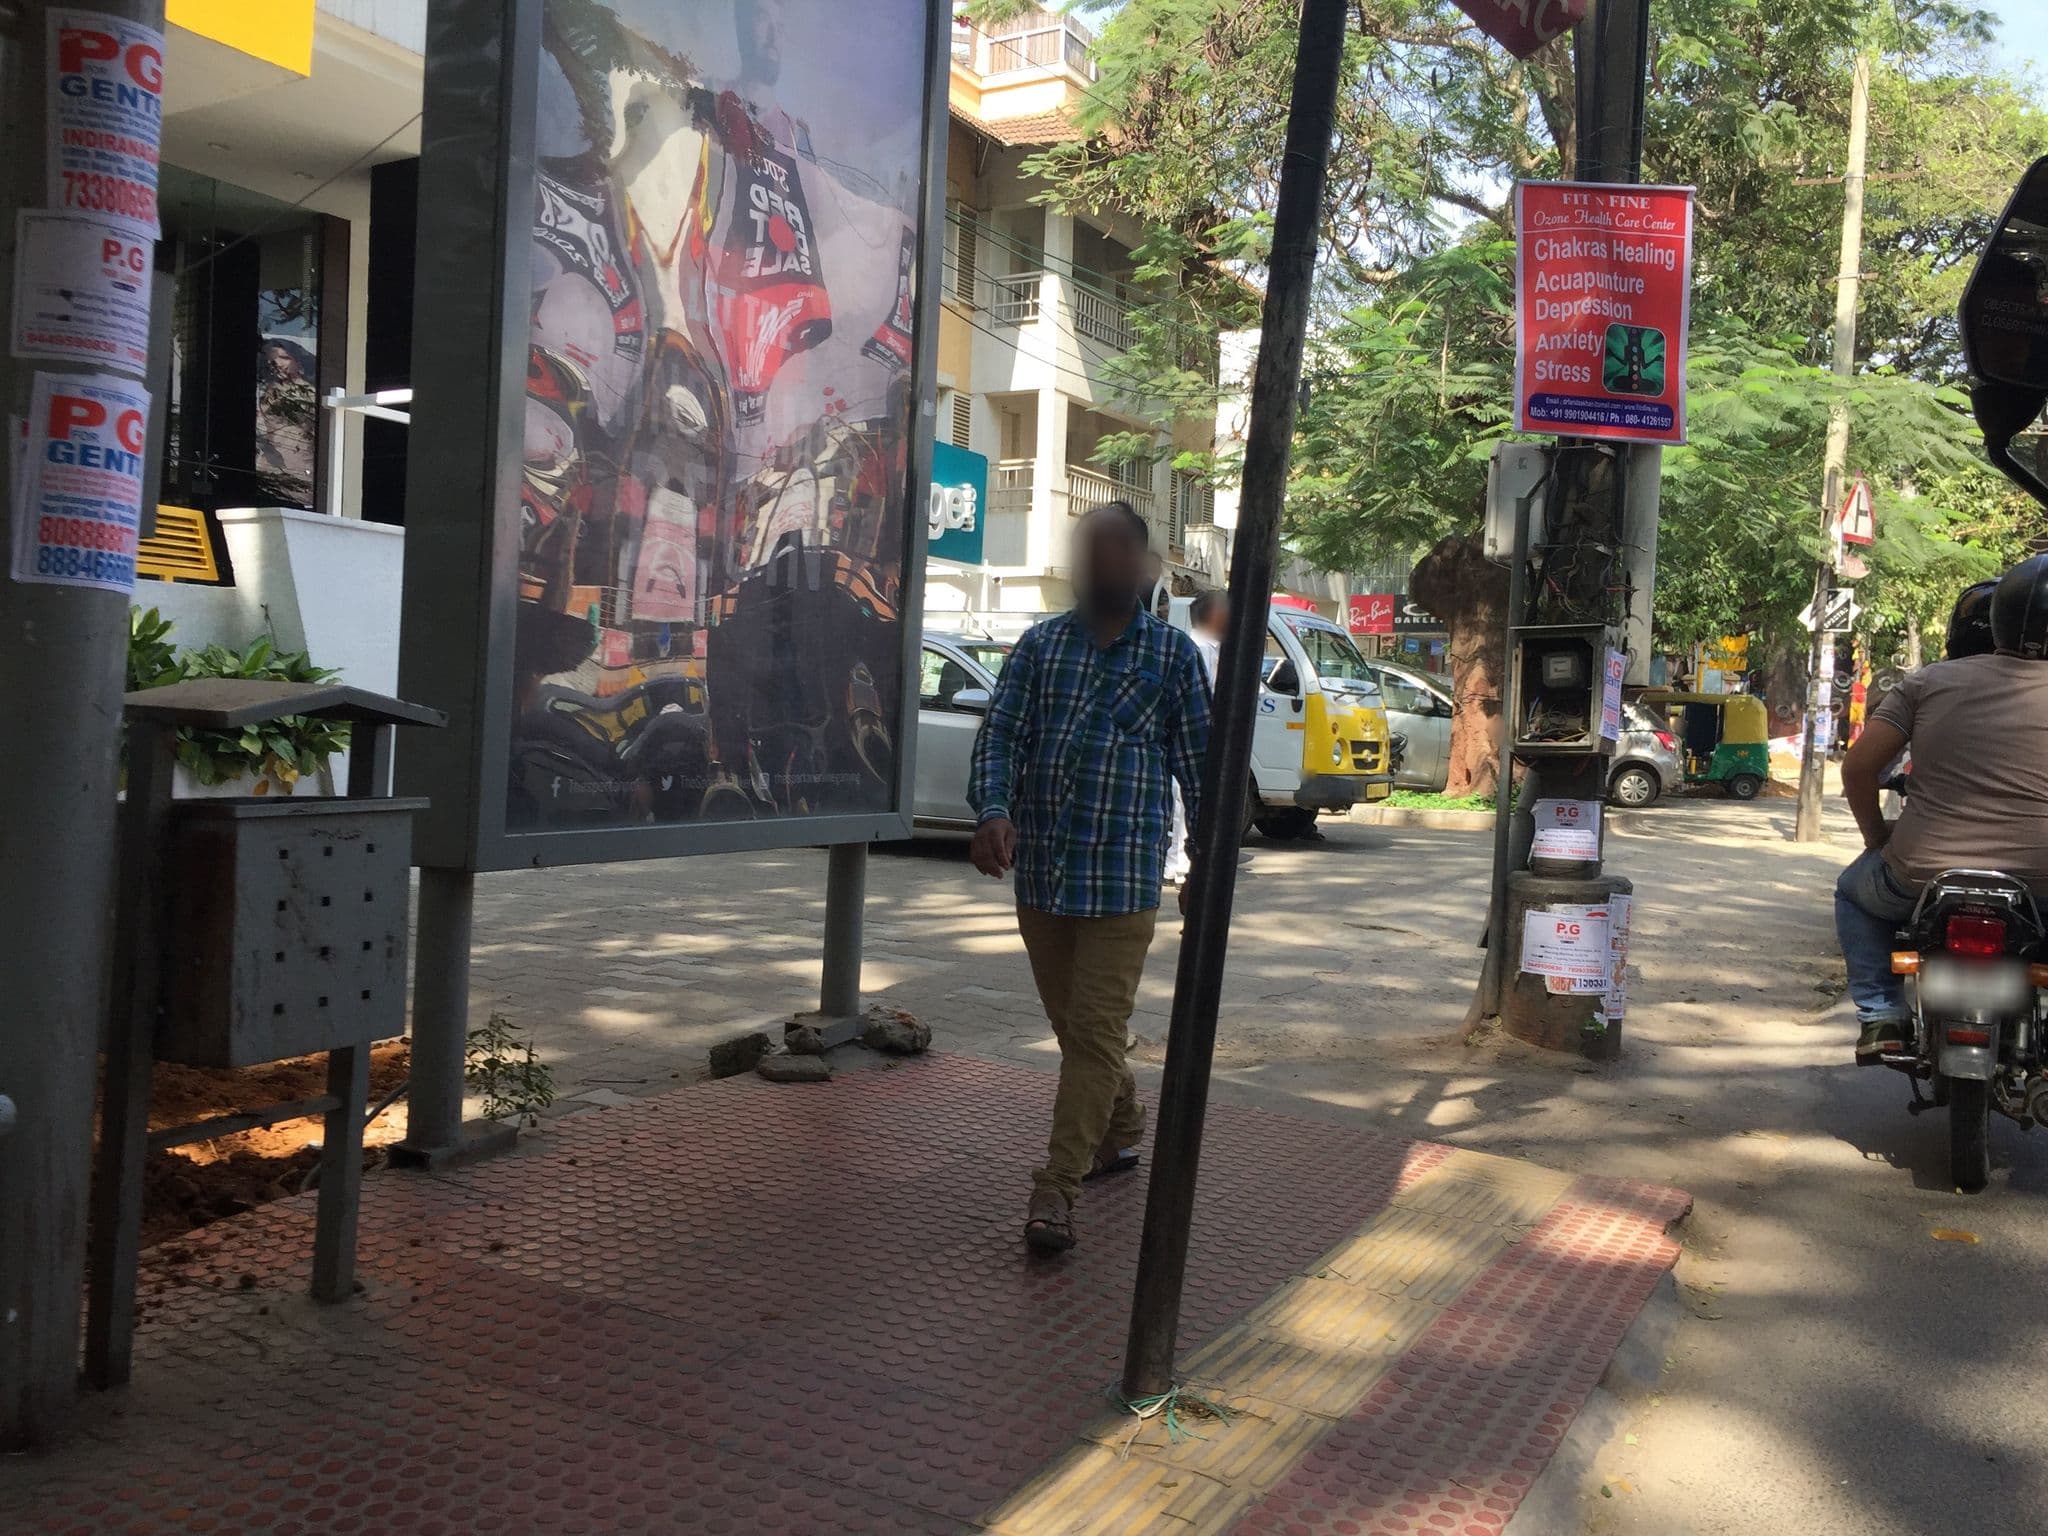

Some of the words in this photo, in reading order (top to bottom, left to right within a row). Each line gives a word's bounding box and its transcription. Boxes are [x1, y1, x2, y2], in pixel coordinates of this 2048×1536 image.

[1609, 194, 1651, 210] FINE
[1534, 211, 1570, 226] Ozone
[1575, 209, 1612, 227] Health
[1615, 212, 1640, 229] Care
[1642, 214, 1677, 232] Center
[1534, 236, 1608, 262] Chakras
[1613, 239, 1676, 271] Healing
[1534, 270, 1645, 295] Acuapunture
[1535, 297, 1633, 322] Depression
[1534, 328, 1604, 357] Anxiety
[1535, 359, 1592, 384] Stress
[1349, 600, 1393, 627] Ray-Ban
[1394, 616, 1444, 625] OAKLE
[1555, 805, 1580, 819] P.G
[1556, 922, 1580, 936] P.G
